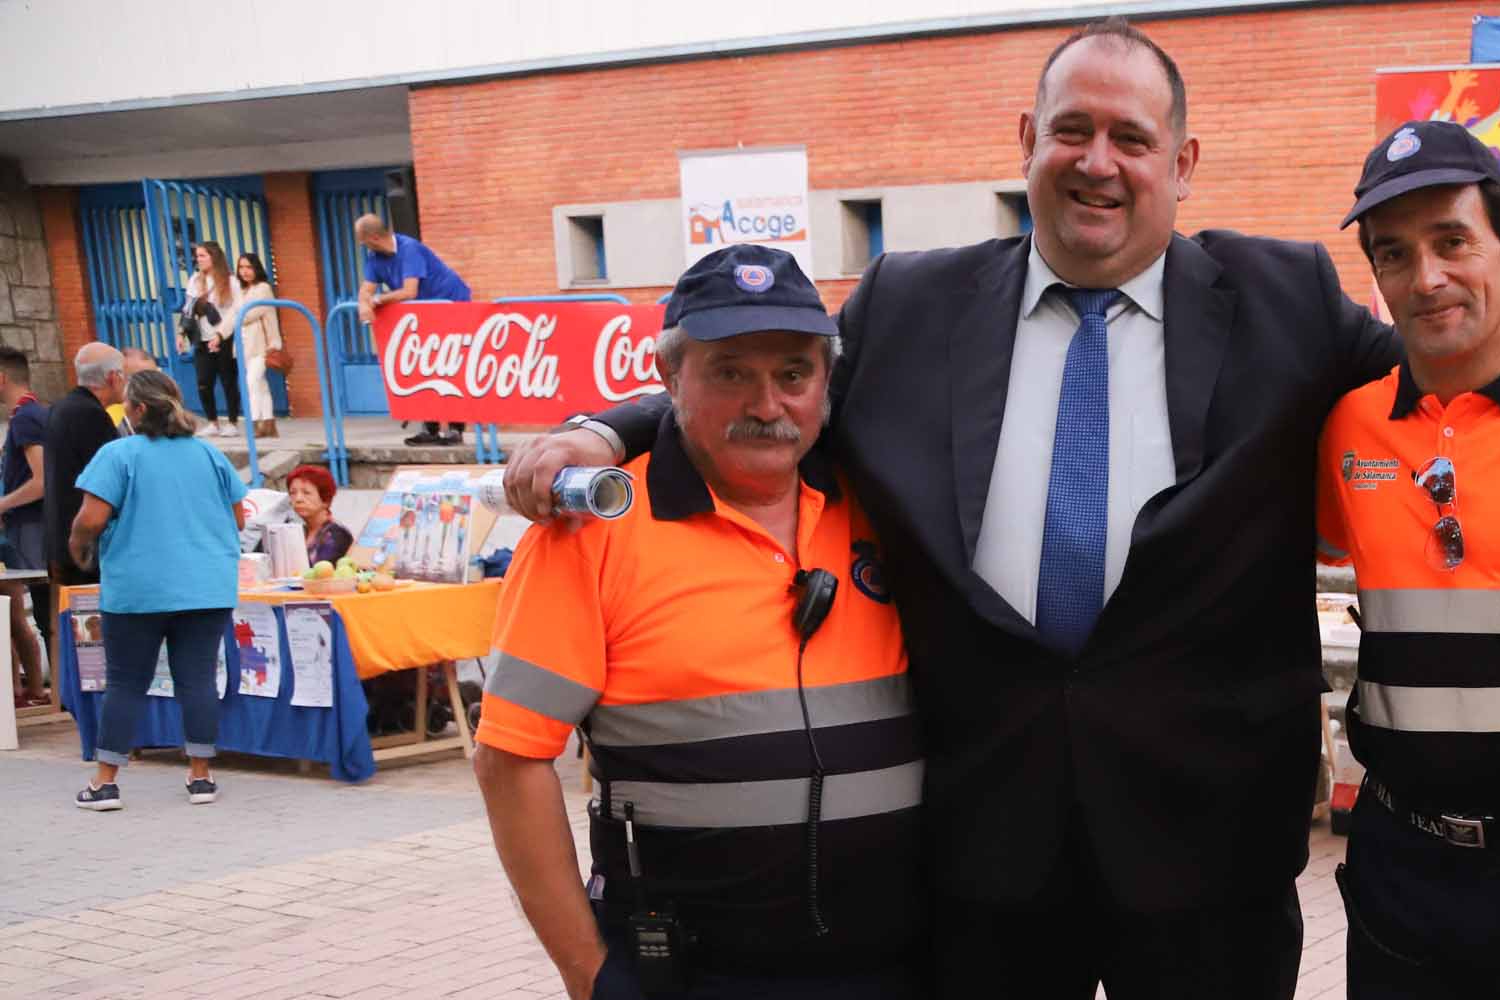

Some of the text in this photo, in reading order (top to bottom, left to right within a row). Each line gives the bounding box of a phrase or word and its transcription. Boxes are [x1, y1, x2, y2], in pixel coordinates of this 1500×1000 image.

[722, 199, 796, 239] Acoge
[384, 313, 664, 401] Coca-Cola Coc
